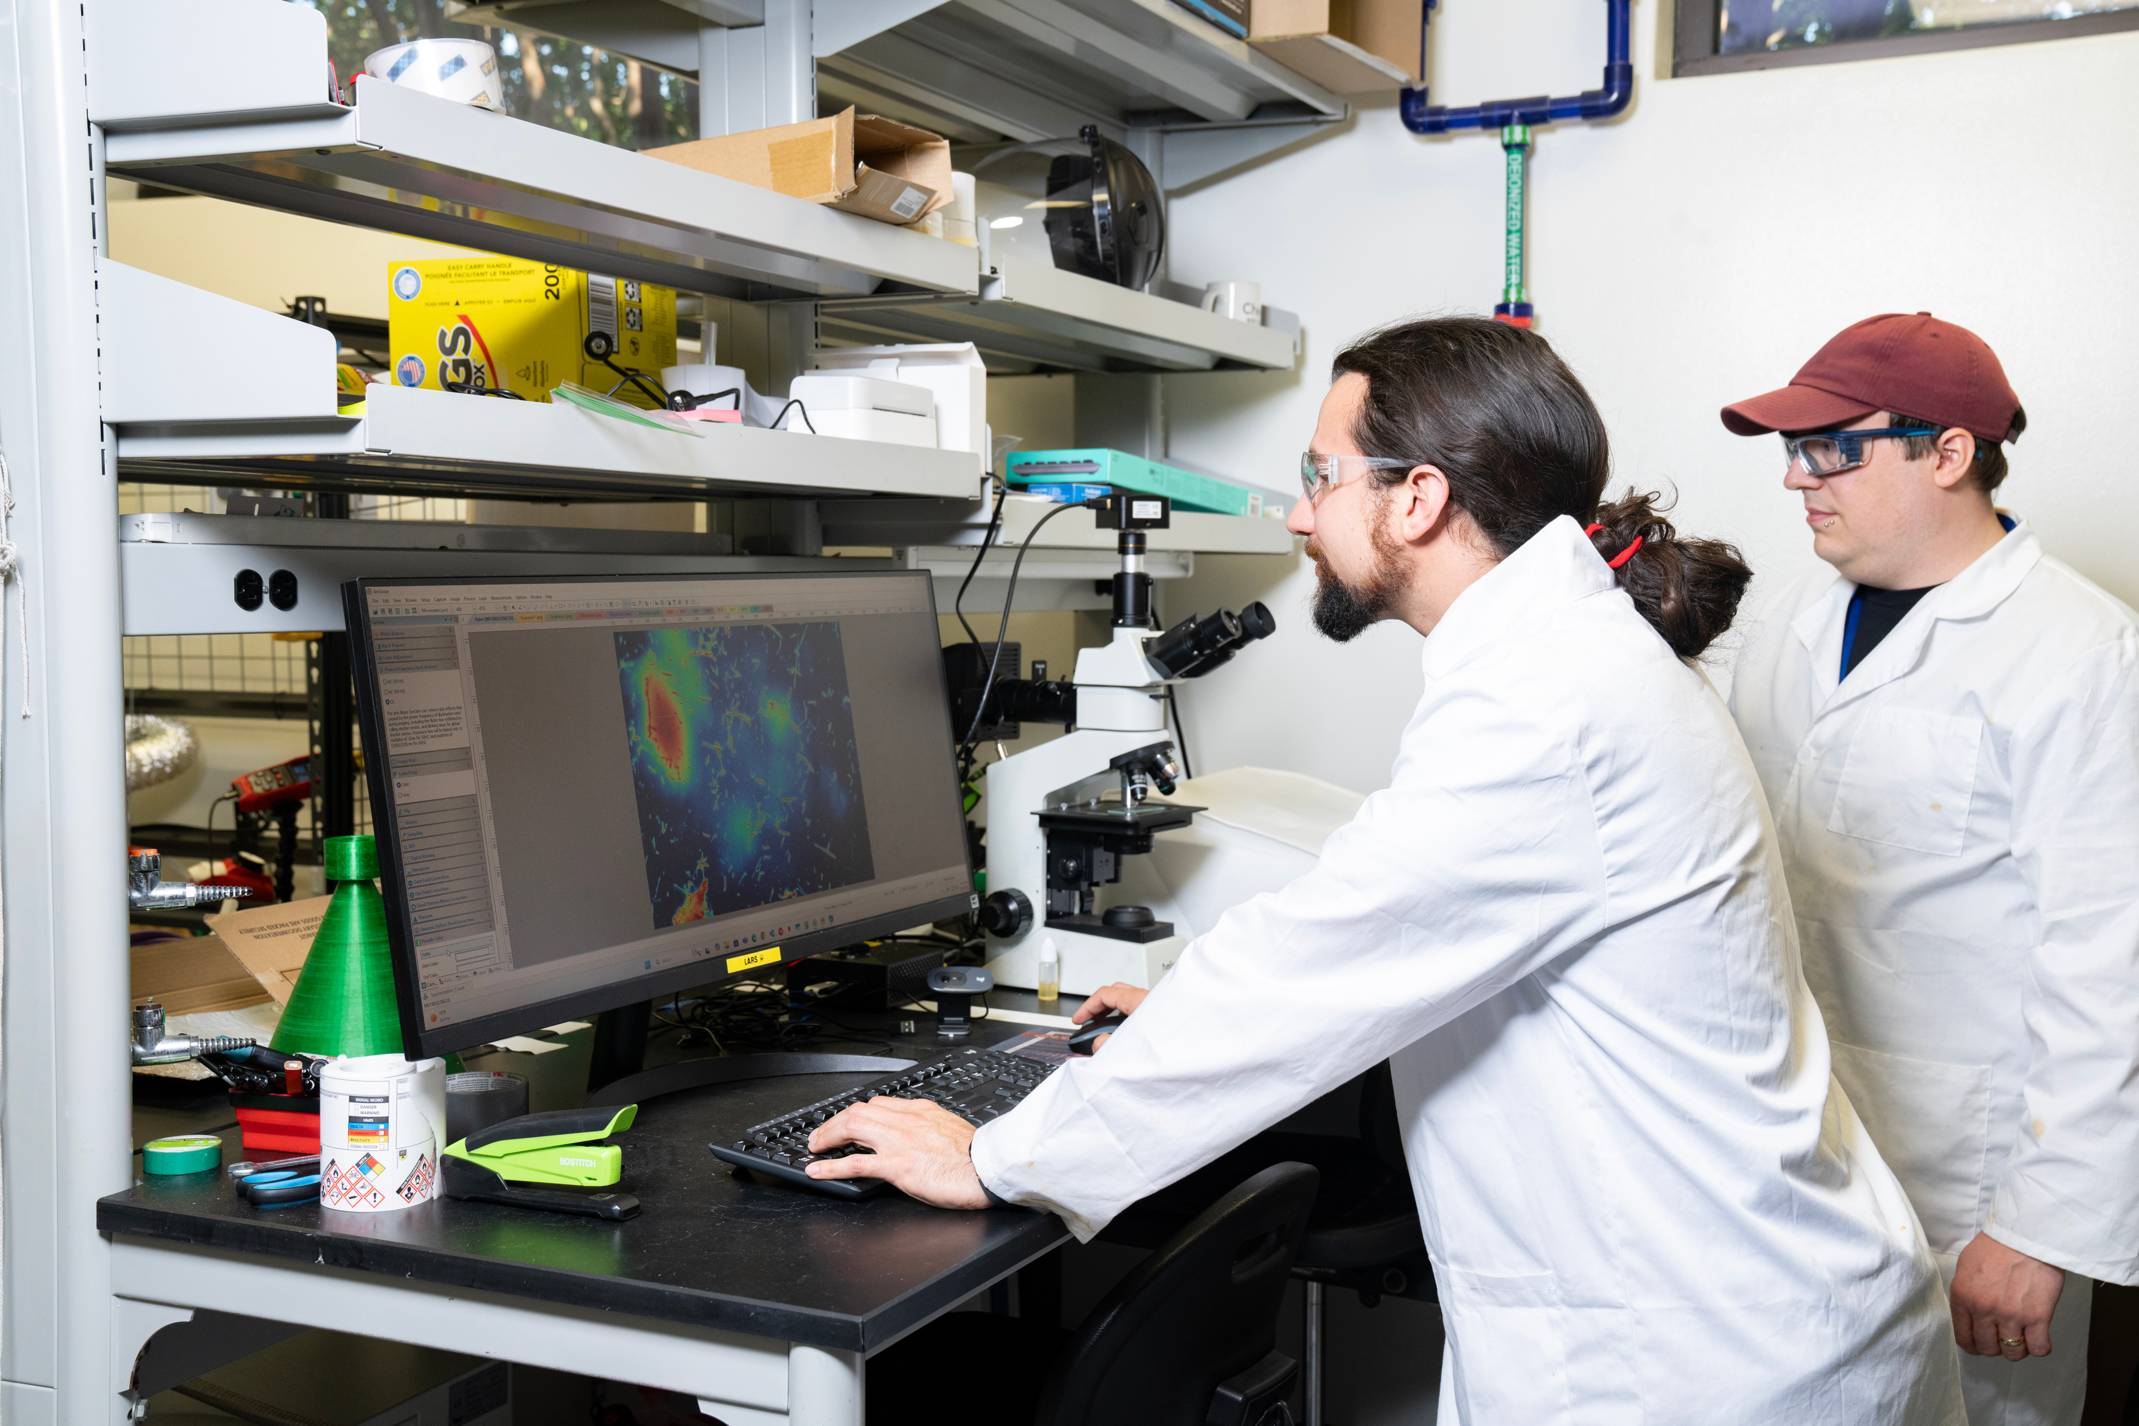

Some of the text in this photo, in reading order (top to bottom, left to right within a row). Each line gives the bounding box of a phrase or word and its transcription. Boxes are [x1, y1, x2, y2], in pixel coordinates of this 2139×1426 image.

[1506, 154, 1522, 284] DEIONIZED WATER
[559, 1157, 597, 1168] BOSTITCH
